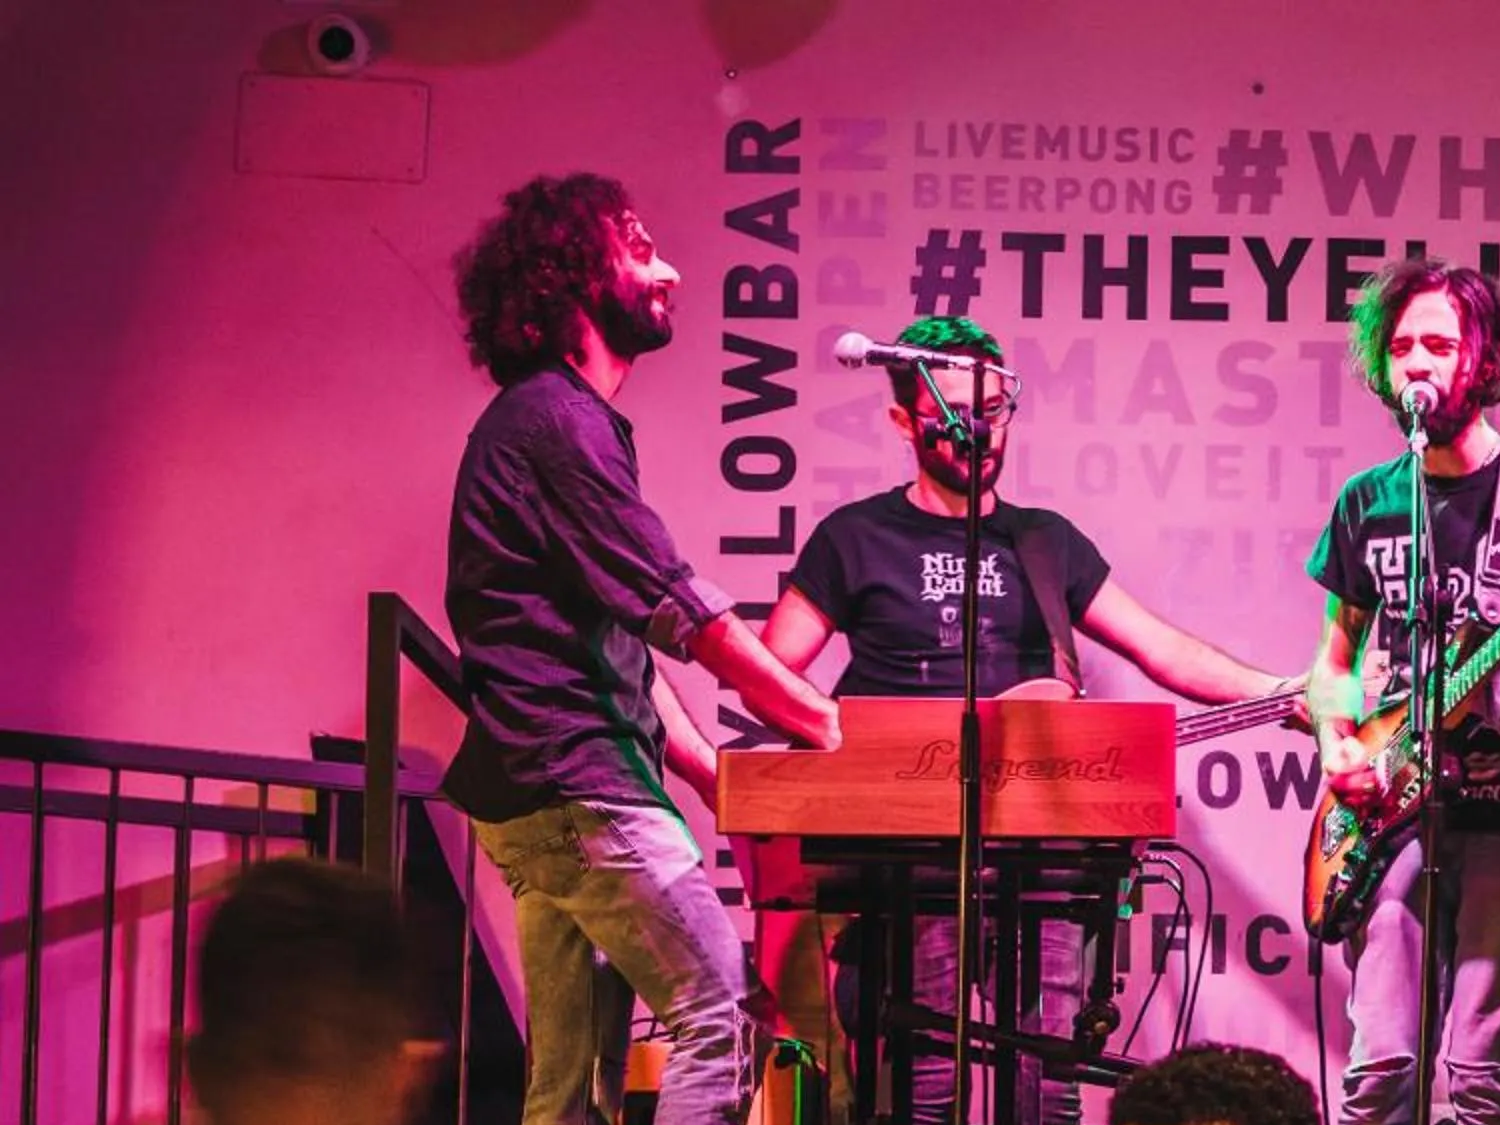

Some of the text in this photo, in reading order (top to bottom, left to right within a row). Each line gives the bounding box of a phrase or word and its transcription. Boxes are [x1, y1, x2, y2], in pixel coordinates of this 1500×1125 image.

[914, 121, 1195, 164] LIVEMUSIC
[912, 173, 1193, 215] BEERPONG
[896, 739, 1124, 792] Lgend
